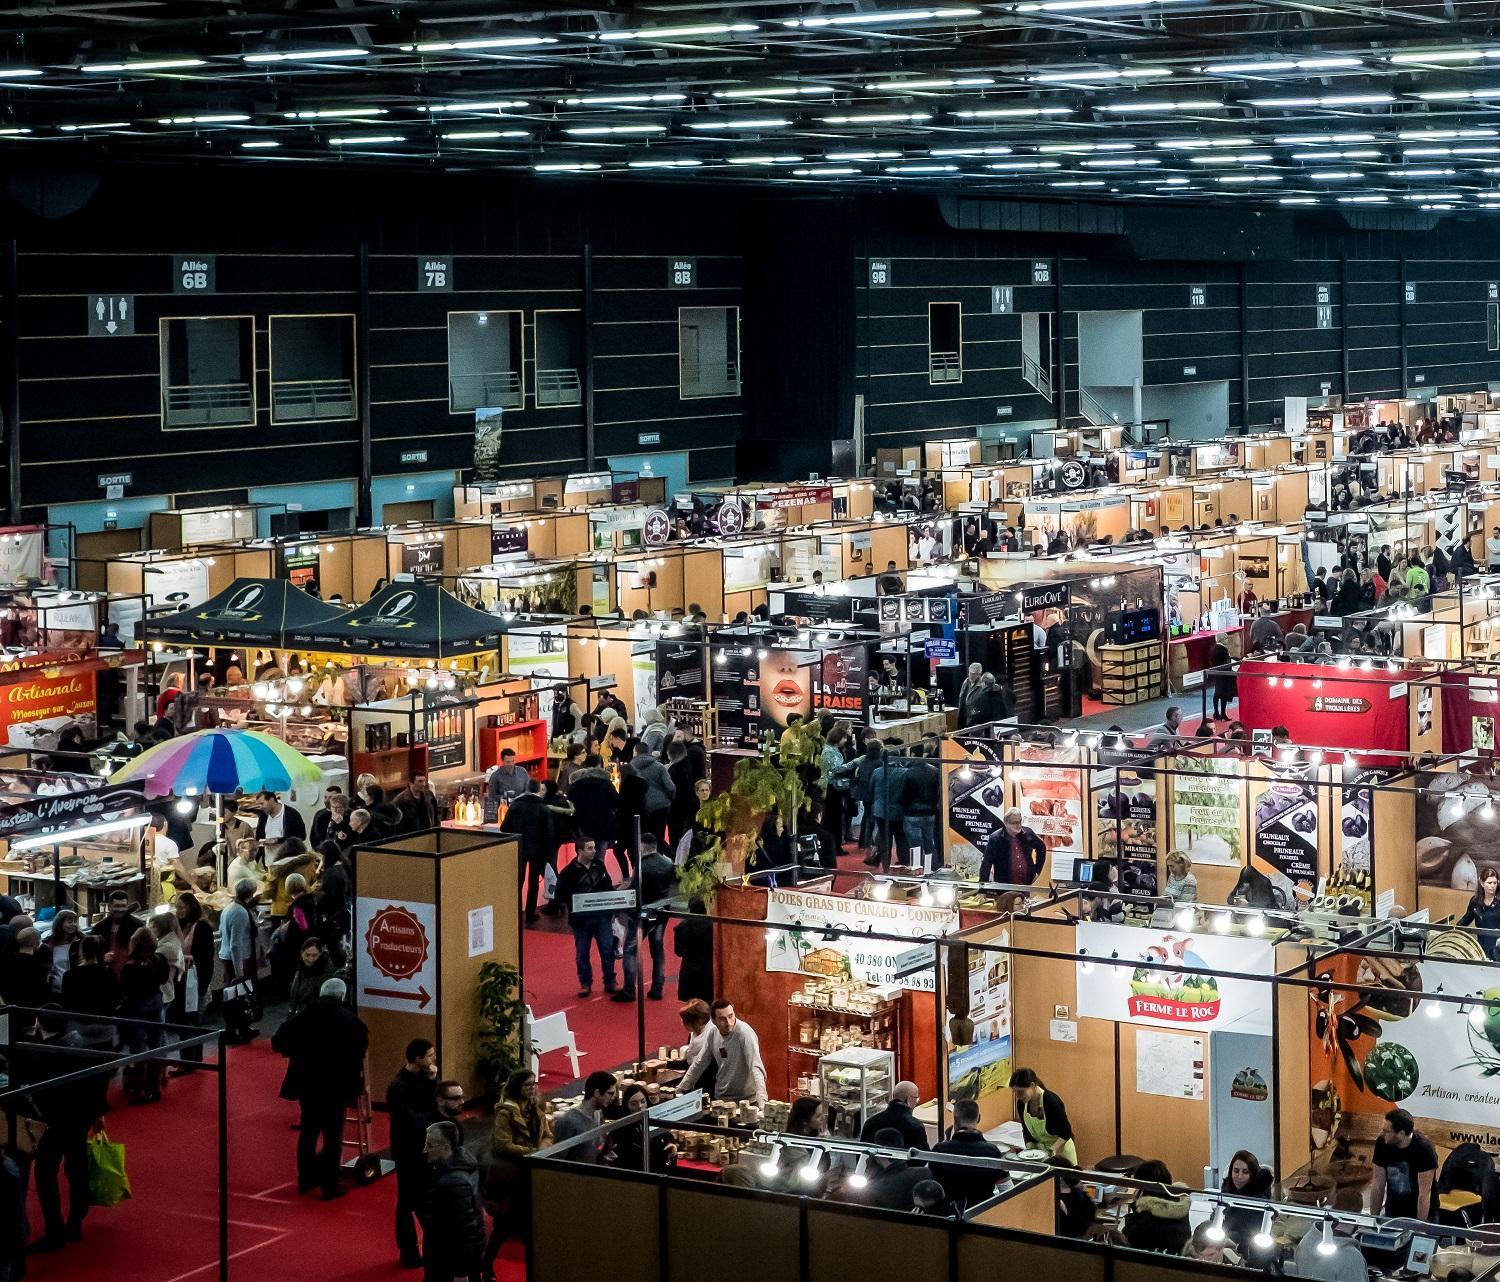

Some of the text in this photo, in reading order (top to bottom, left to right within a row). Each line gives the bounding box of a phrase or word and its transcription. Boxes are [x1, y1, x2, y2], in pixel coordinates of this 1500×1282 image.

[181, 260, 208, 271] Allée
[424, 261, 447, 271] Allée
[673, 261, 692, 271] Allée
[871, 262, 887, 270] Allée
[182, 272, 207, 289] 6B
[425, 272, 446, 287] 7B
[674, 271, 691, 285] 8B
[872, 271, 886, 284] 9B
[1034, 271, 1049, 282] 10B
[1191, 294, 1205, 305] 11B
[1317, 293, 1329, 303] 12B
[639, 433, 660, 443] SORTIE
[401, 452, 427, 461] SORTIE
[99, 475, 131, 486] SORTIE
[772, 496, 817, 508] PEZENAS
[813, 681, 831, 695] LA
[813, 694, 863, 709] FRAISE
[1324, 697, 1351, 705] DOMAINE
[52, 705, 65, 714] sur
[952, 807, 981, 815] PRUNEAUX
[965, 821, 993, 829] PRUNEAUX
[1259, 833, 1290, 841] PRUNEAUX
[1273, 847, 1305, 856] PRUNEAUX
[771, 890, 898, 919] FOIES GRAS DE CANARD
[379, 918, 415, 936] Artisans
[371, 933, 422, 954] Producteurs
[854, 953, 865, 965] 40
[866, 954, 883, 967] 380
[866, 971, 883, 983] Tel:
[885, 973, 897, 985] 05
[923, 976, 935, 989] 93
[1135, 1000, 1217, 1019] FERME LE ROC
[1421, 1084, 1462, 1102] Artisan,
